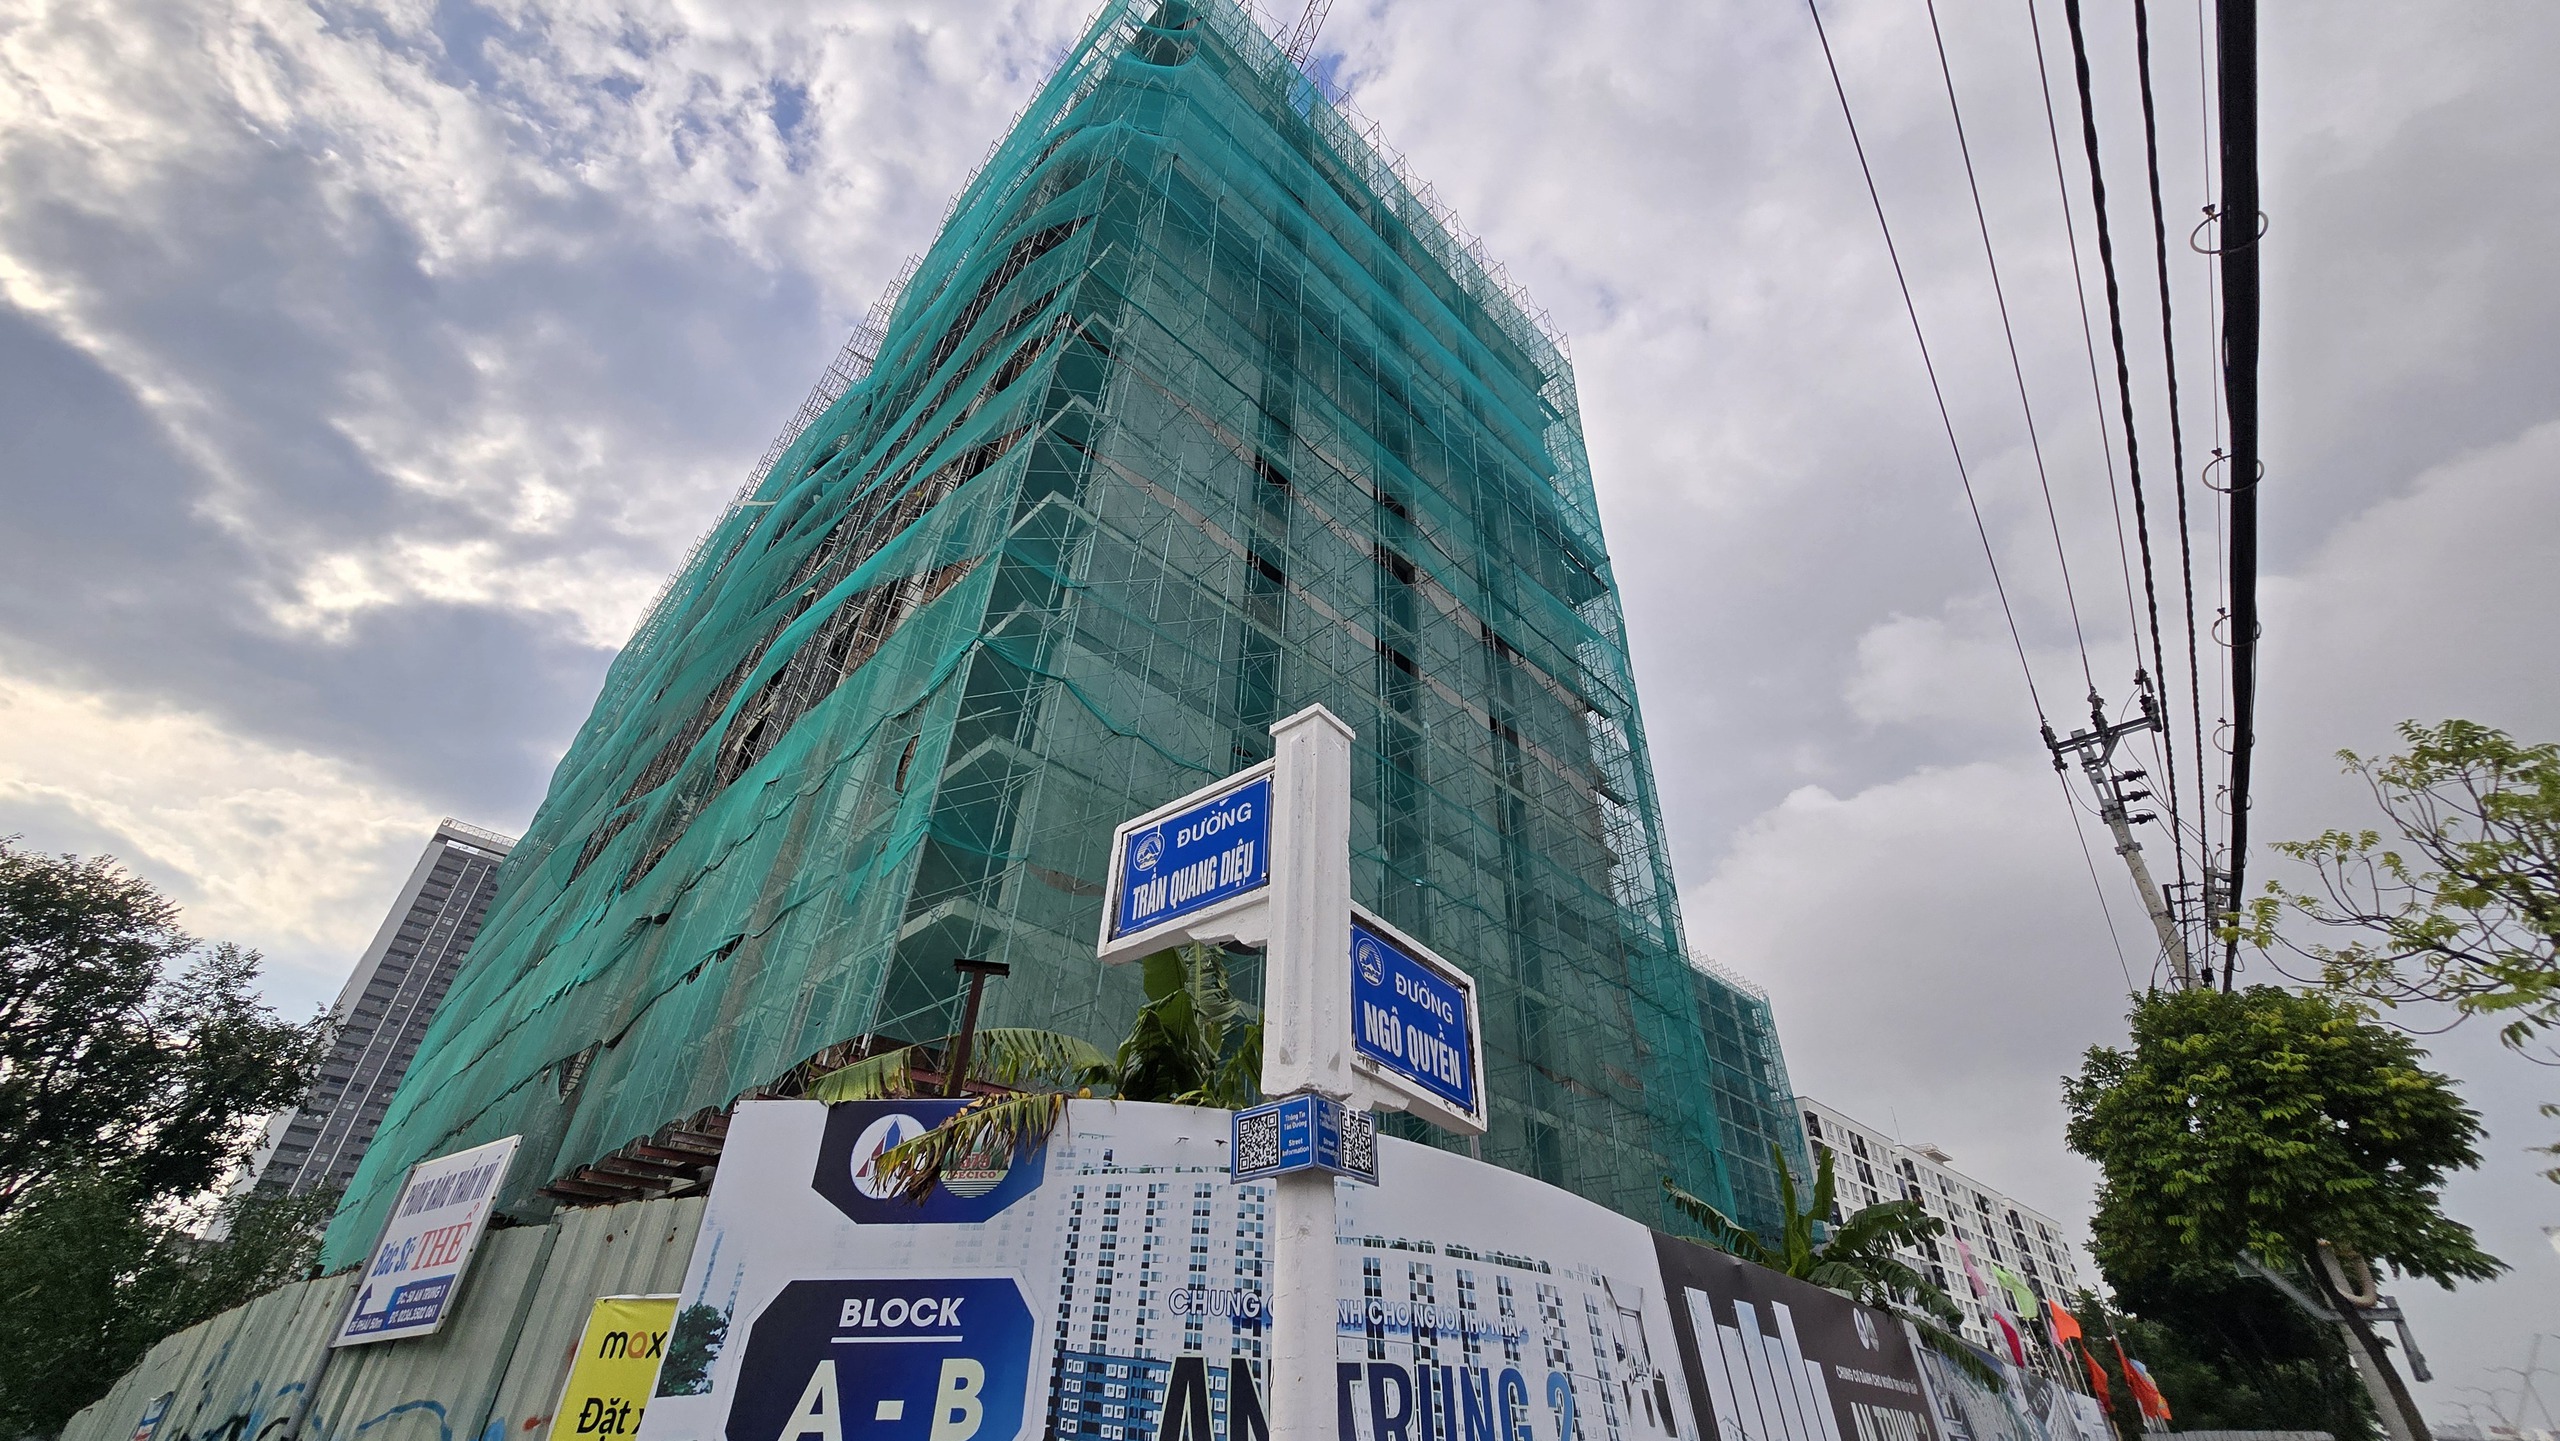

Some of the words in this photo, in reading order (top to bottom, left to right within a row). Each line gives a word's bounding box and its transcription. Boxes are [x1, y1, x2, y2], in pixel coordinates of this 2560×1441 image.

[1177, 803, 1252, 848] ĐƯỜNG
[1132, 866, 1168, 921] TRẦN
[1169, 855, 1218, 910] QUANG
[1219, 838, 1255, 888] DIỆU
[1395, 971, 1453, 1025] ĐƯỜNG
[1363, 1000, 1402, 1058] NGÔ
[1407, 1023, 1462, 1090] QUYỀN
[371, 1240, 400, 1277] Bác
[411, 1202, 480, 1271] THỂ
[839, 1297, 964, 1328] BLOCK
[1169, 1288, 1261, 1318] CHUNG
[1336, 1299, 1363, 1325] NH
[1368, 1300, 1411, 1327] CHO
[576, 1397, 631, 1441] Đặt
[780, 1359, 842, 1441] A
[930, 1358, 985, 1441] B
